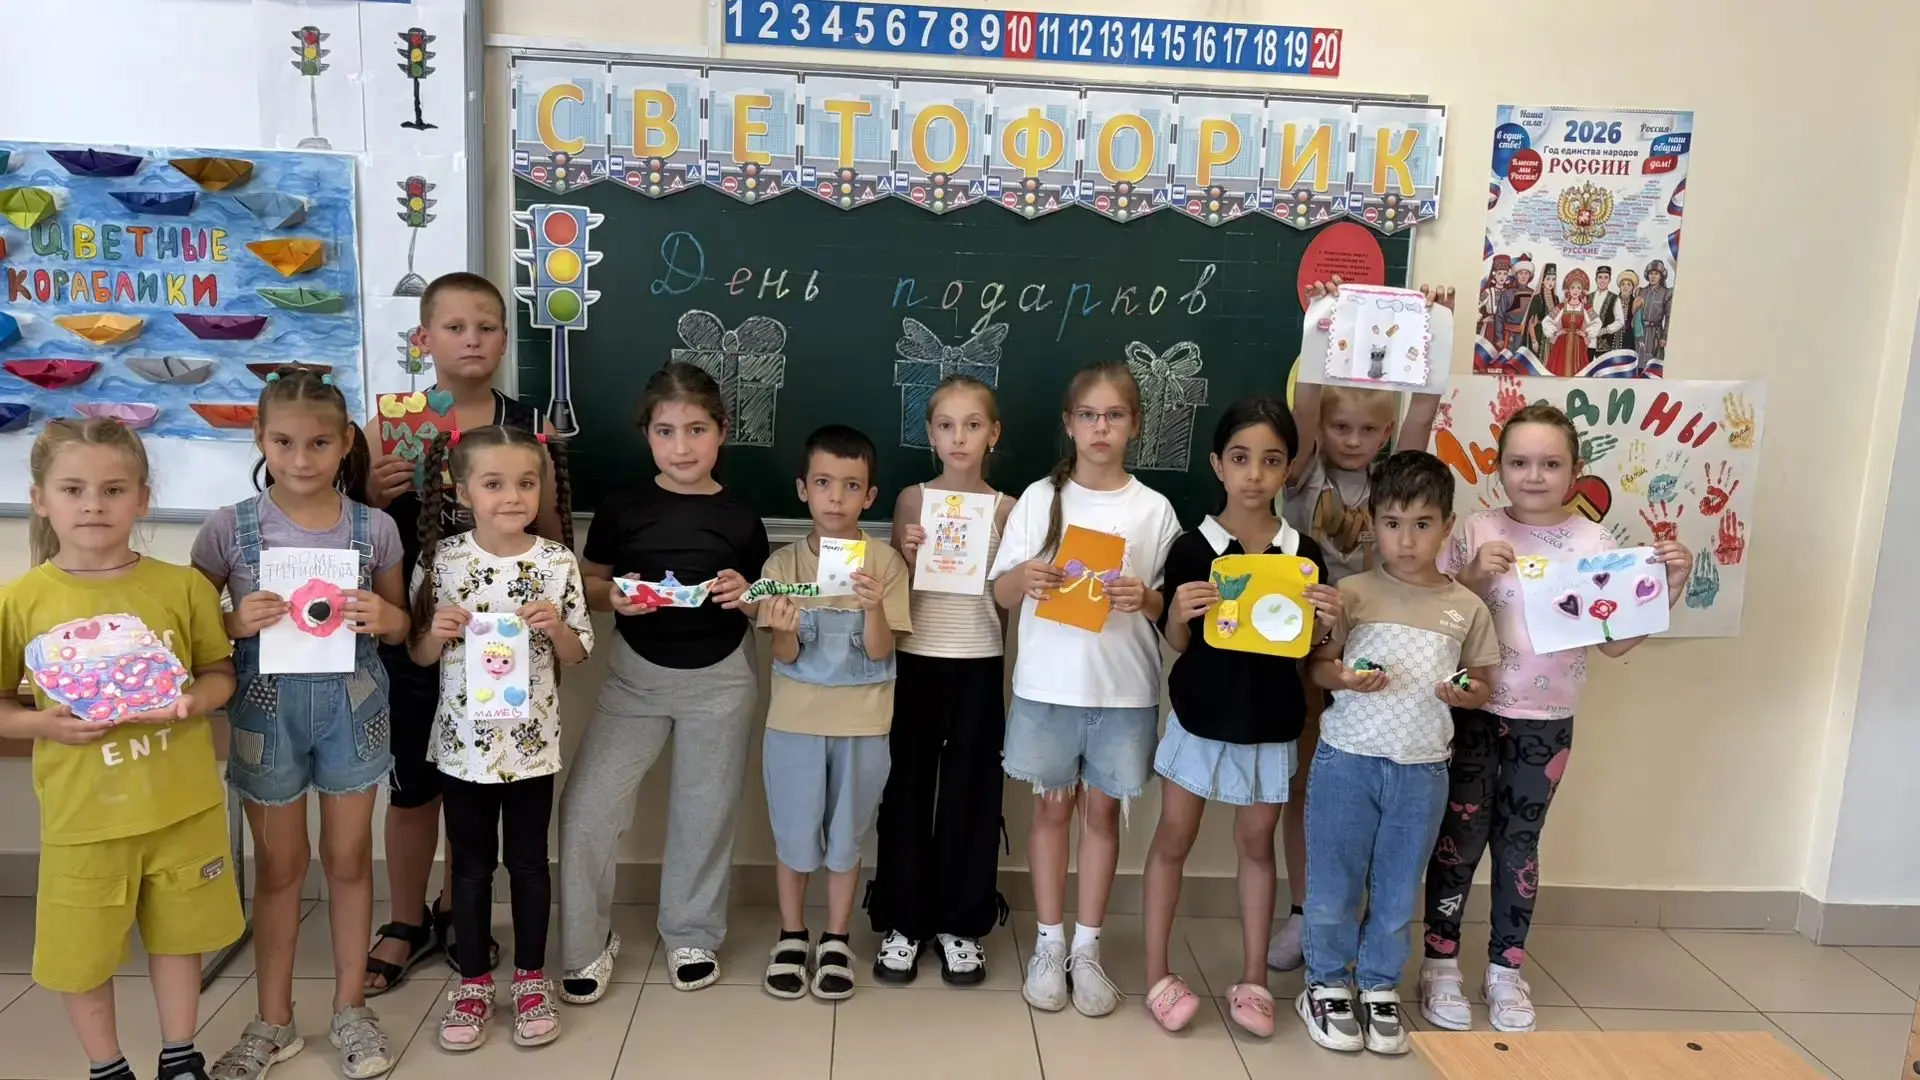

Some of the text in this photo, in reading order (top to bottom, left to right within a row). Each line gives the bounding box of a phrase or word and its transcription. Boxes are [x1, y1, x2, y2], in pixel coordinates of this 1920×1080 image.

[729, 0, 1339, 69] 1 2 3 4 5 6 7 8 9 10 11 12 13 14 15 16 17 18 19 20
[1519, 109, 1543, 118] Наша
[1563, 119, 1622, 144] 2026
[535, 83, 1420, 197] СВЕТОФОРИК
[1543, 146, 1638, 157] Год единства народов
[1548, 158, 1630, 176] РОССИИ
[30, 222, 230, 262] ЦВЕТНЫЕ
[1563, 246, 1599, 255] РУССКИЕ
[7, 267, 218, 307] КОРАБЛИКИ
[650, 231, 1217, 341] День подарков
[1533, 387, 1718, 448] ДИНЫ
